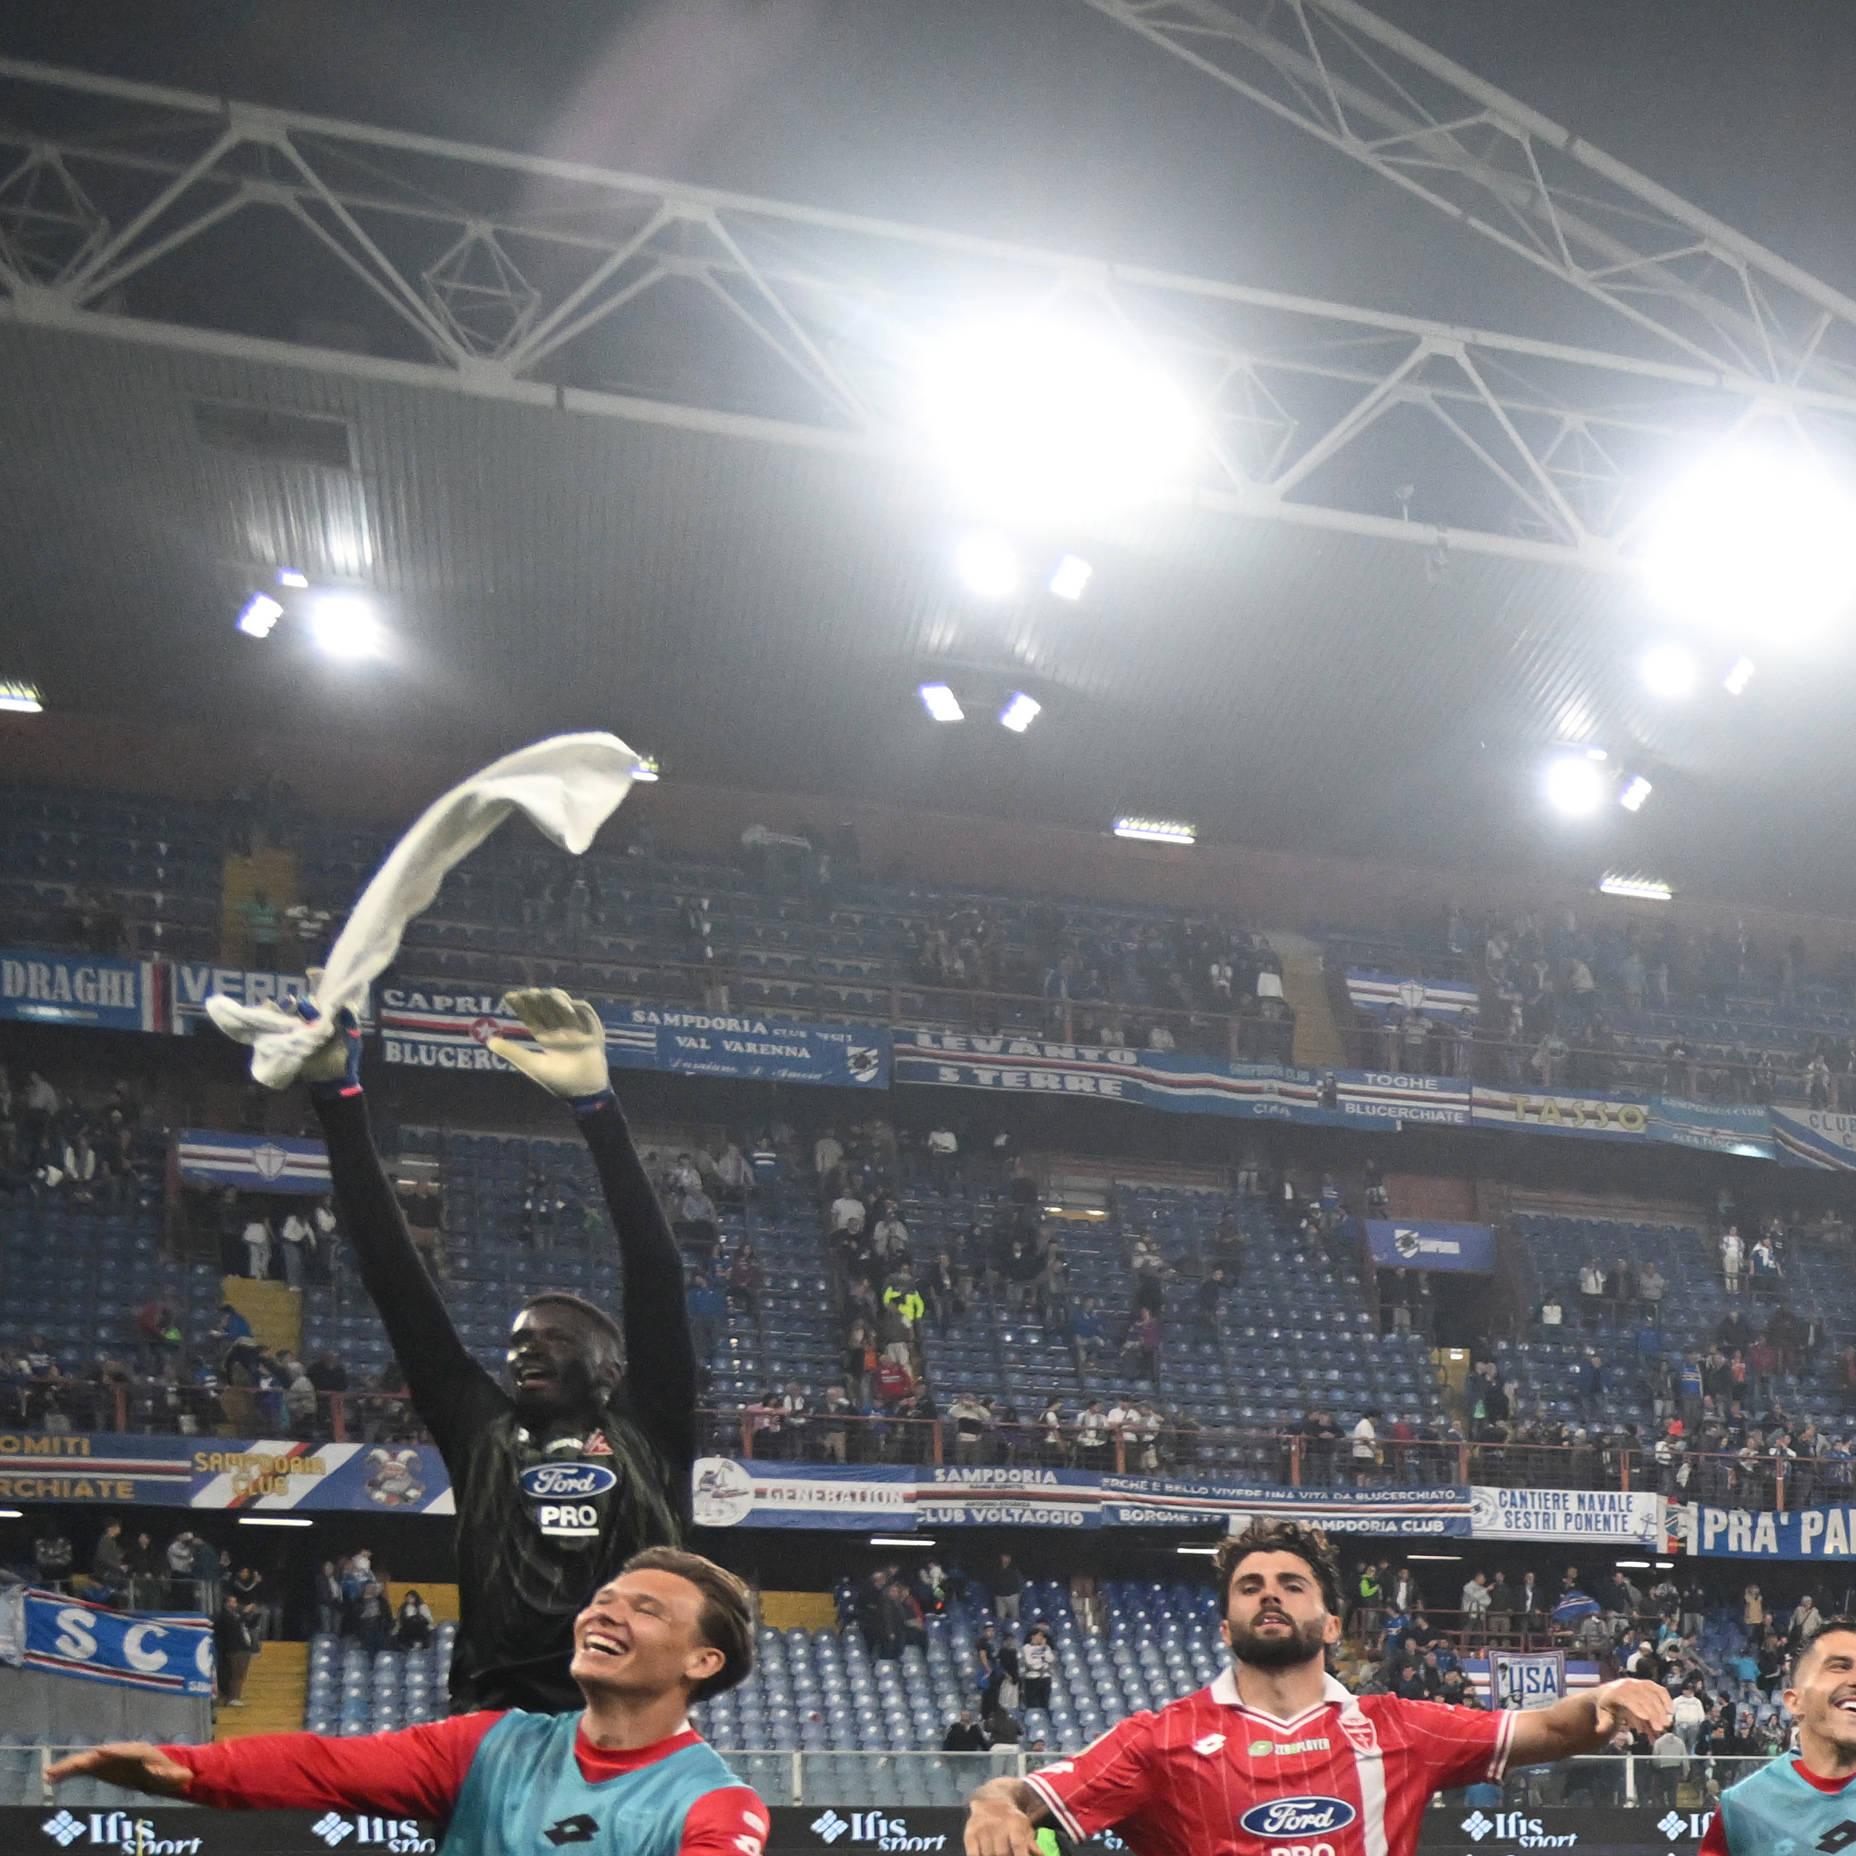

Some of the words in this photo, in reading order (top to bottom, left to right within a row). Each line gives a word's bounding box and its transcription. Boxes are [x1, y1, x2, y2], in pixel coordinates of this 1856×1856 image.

[3, 960, 136, 1008] DRAGHI
[632, 1010, 768, 1035] SAMPDORIA
[676, 1036, 711, 1049] VAL
[722, 1040, 811, 1059] VARENNA
[916, 1030, 1137, 1064] LEVANTO
[974, 1068, 1123, 1096] TERRE
[1364, 1073, 1438, 1090] TOGHE
[1345, 1102, 1465, 1123] BLUCERCHIATE
[1509, 1094, 1645, 1131] TASSO
[232, 1474, 289, 1496] CLUB
[533, 1467, 596, 1494] Ford
[935, 1467, 1057, 1485] SAMPDORIA
[767, 1486, 904, 1506] GENERATION
[1498, 1489, 1569, 1511] CANTIERE
[1577, 1492, 1633, 1513] NAVALE
[541, 1505, 598, 1527] PRO
[975, 1508, 1084, 1526] VOLTAGGIO
[1402, 1519, 1445, 1533] CLUB
[1504, 1510, 1557, 1530] SESTRI
[1563, 1511, 1630, 1533] PONENTE
[1510, 1666, 1556, 1695] USA
[90, 1811, 155, 1844] Ifis
[851, 1811, 906, 1840] Ifis
[1262, 1801, 1334, 1833] Ford
[1495, 1812, 1543, 1839] Ifis
